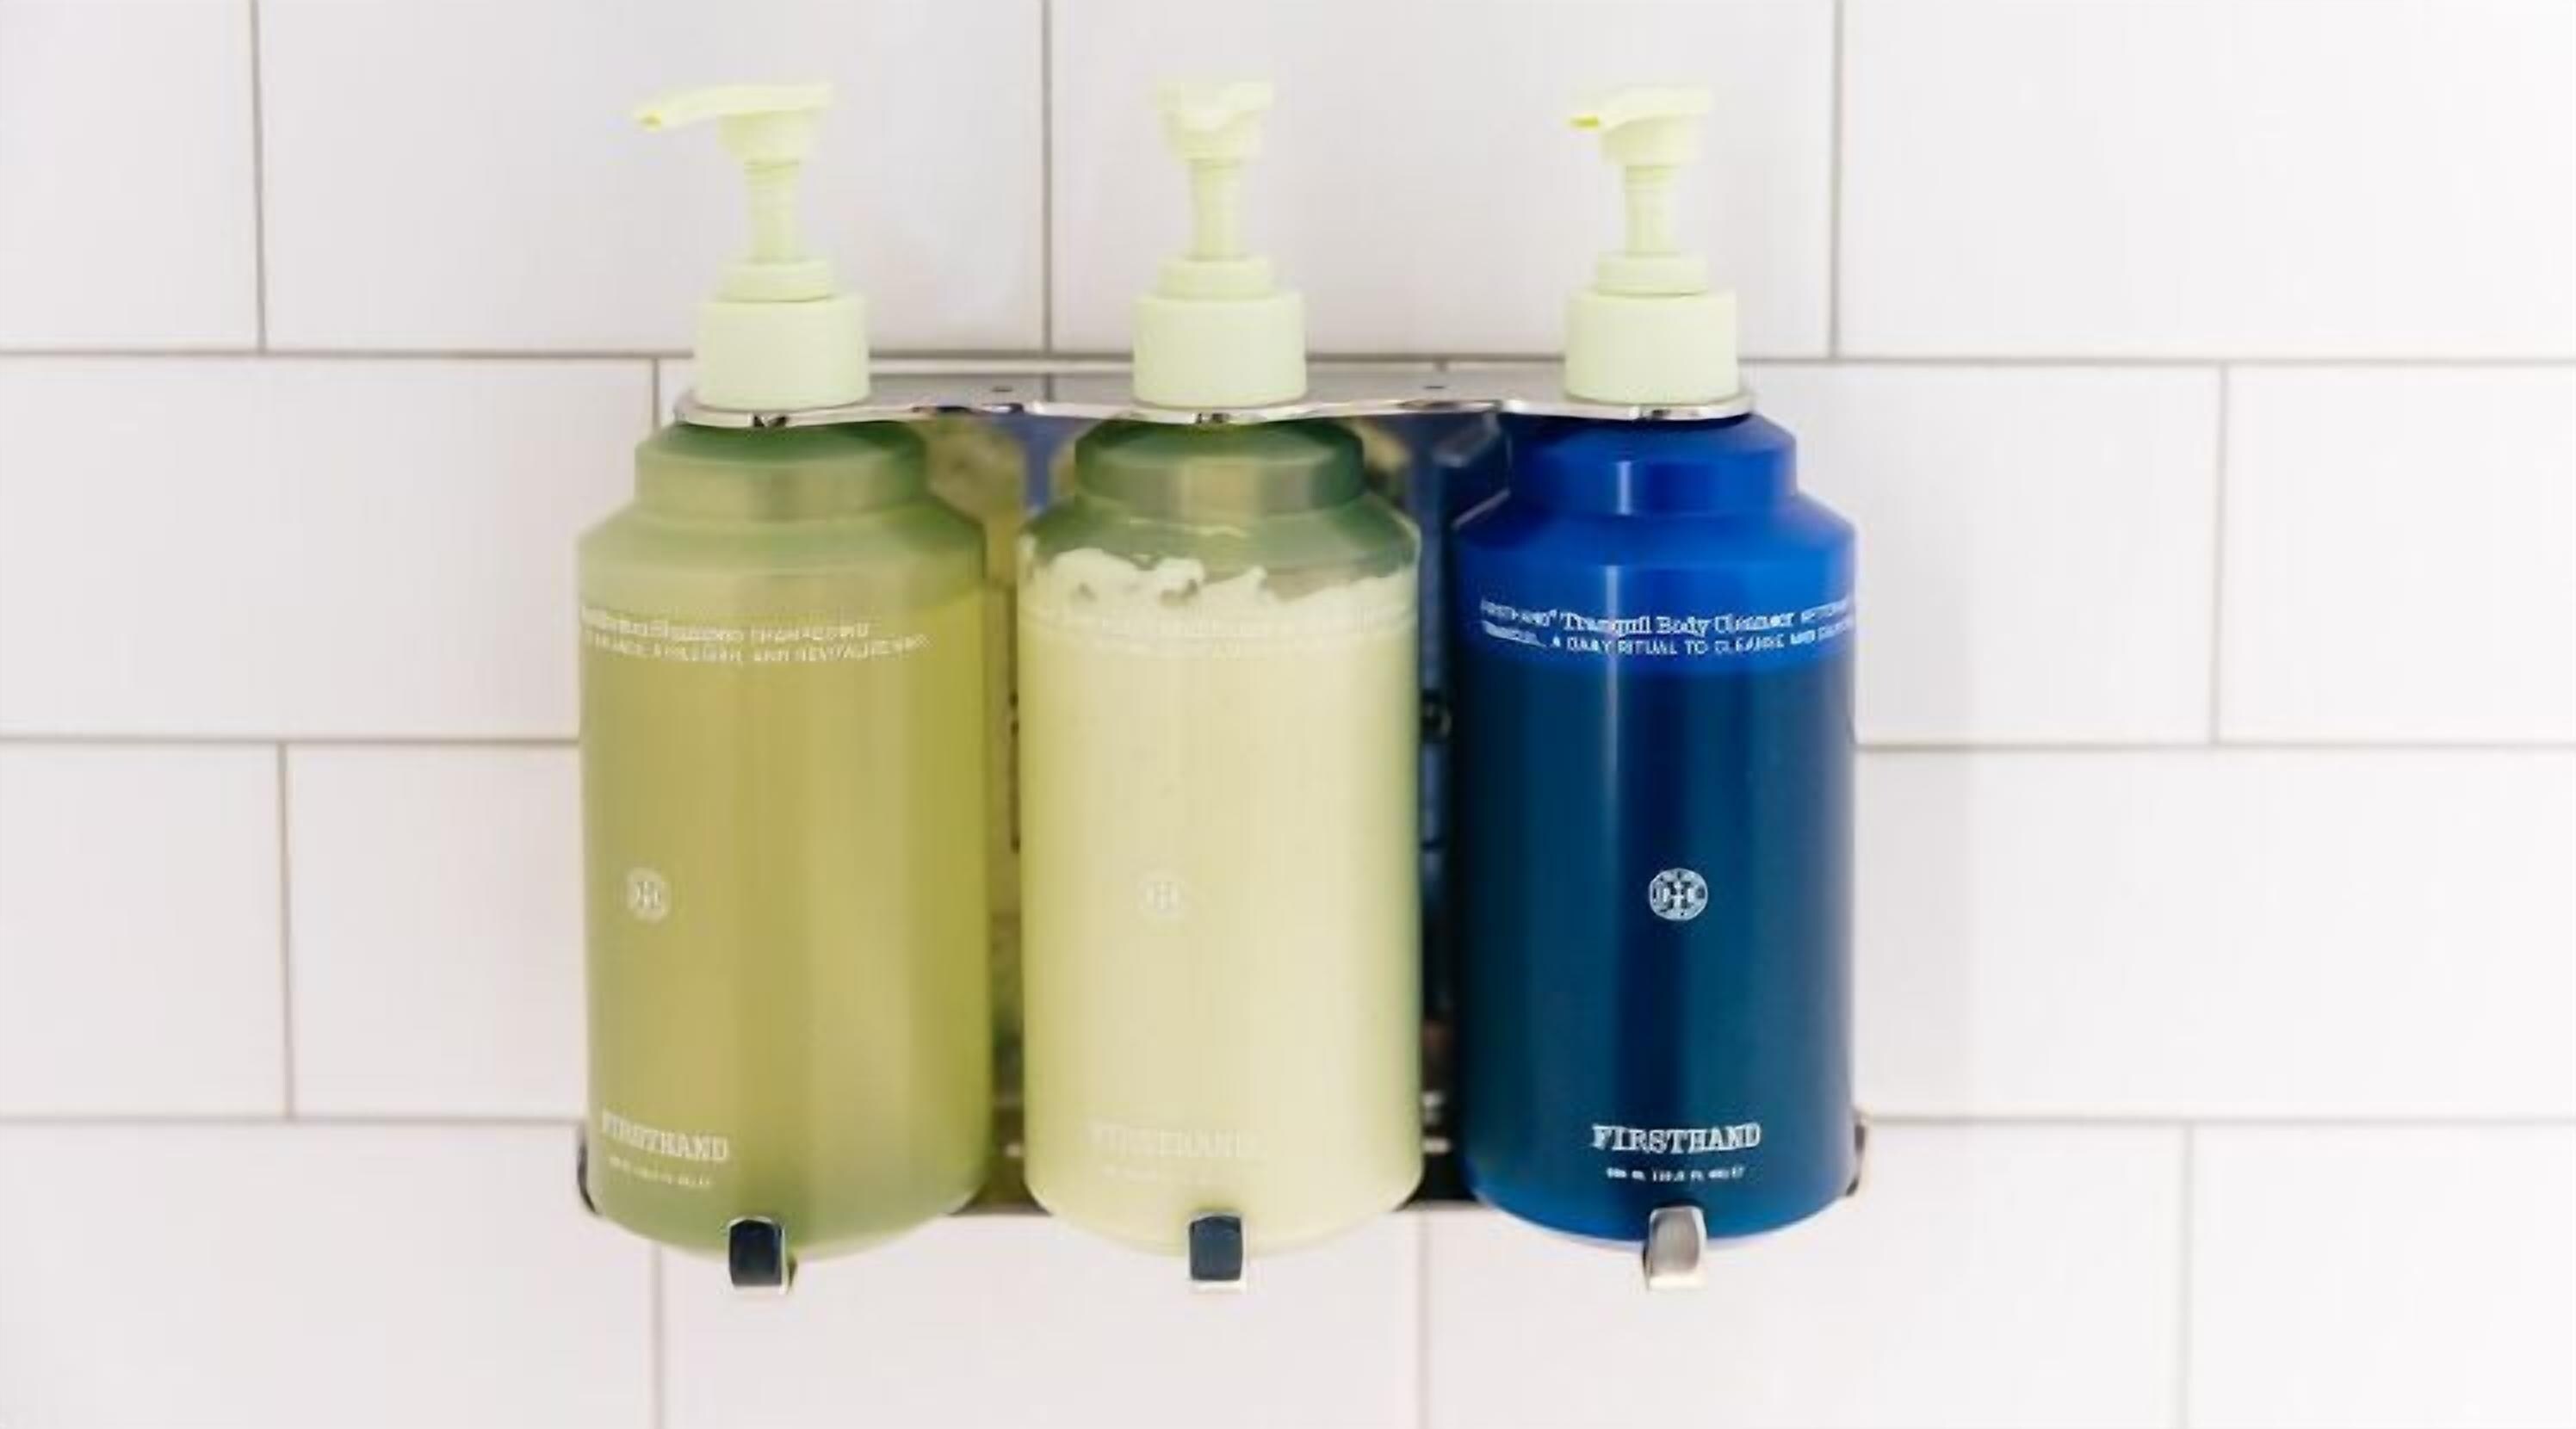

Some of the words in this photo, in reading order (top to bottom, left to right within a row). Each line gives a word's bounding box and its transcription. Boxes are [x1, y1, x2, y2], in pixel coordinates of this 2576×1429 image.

[1656, 616, 1709, 638] Body
[1684, 639, 1709, 656] TO
[1591, 1122, 1762, 1154] FIRSTHAND
